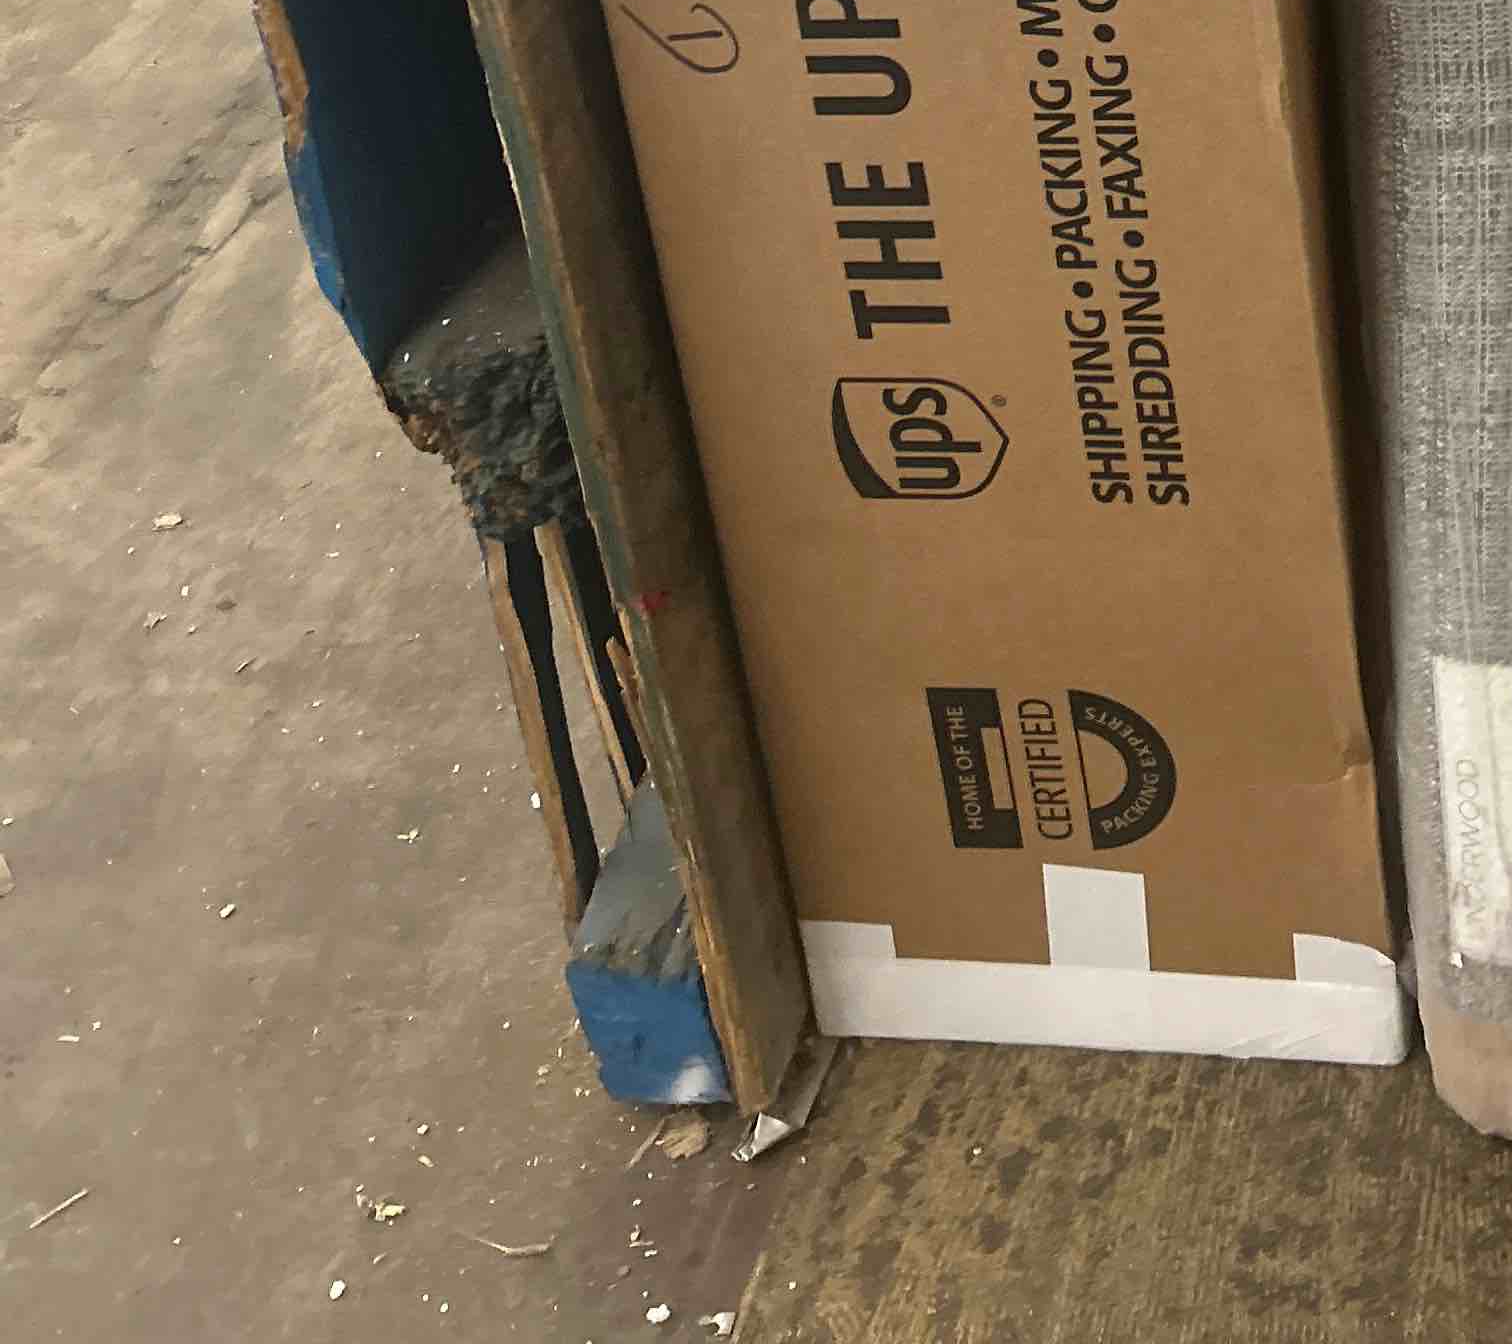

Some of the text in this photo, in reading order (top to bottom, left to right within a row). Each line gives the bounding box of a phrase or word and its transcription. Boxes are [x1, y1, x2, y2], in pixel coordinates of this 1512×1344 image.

[1029, 78, 1098, 272] PACKING
[1085, 52, 1150, 221] FAXING
[824, 160, 952, 341] THE
[882, 385, 982, 491] ups
[1064, 308, 1134, 507] SHIPPING
[1114, 256, 1190, 508] SHREDDING
[946, 705, 984, 831] HOME OF THE
[1016, 698, 1074, 840] CERTIFIED
[1083, 705, 1160, 834] PACKING EXPERTS
